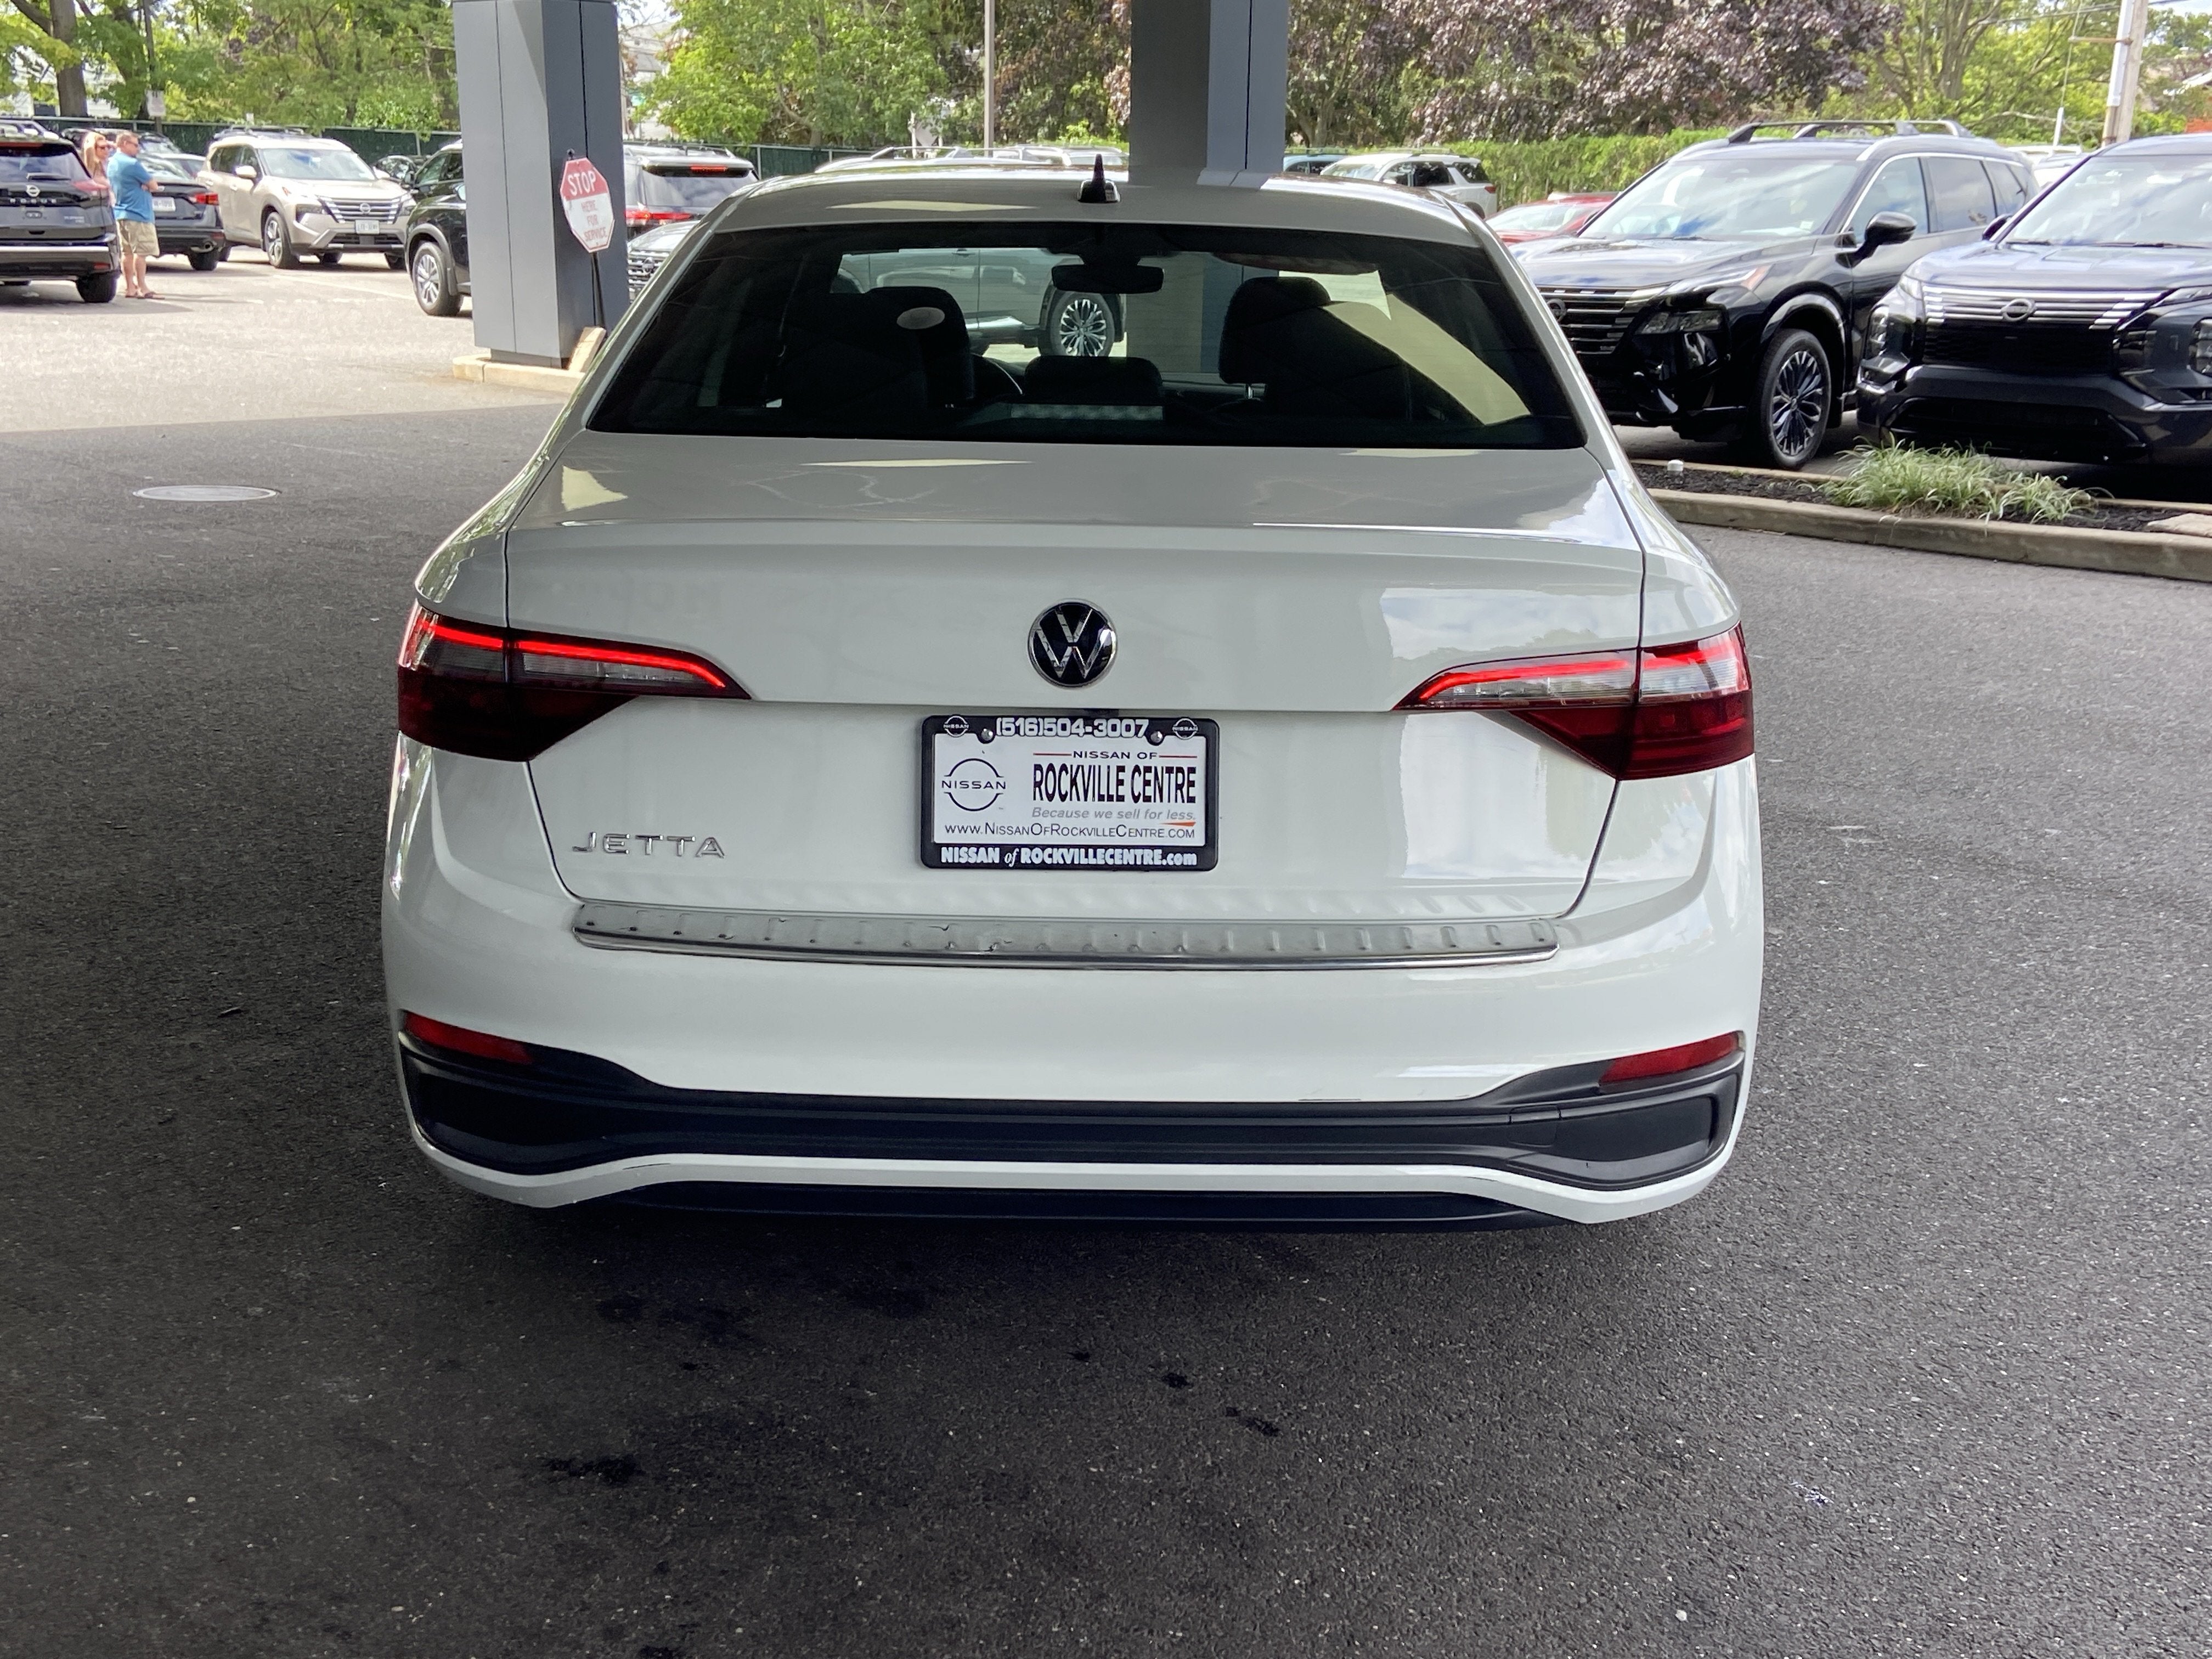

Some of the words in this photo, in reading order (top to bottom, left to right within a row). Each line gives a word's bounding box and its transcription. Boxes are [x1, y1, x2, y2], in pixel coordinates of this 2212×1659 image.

[568, 171, 596, 196] STOP
[581, 200, 597, 212] HERE
[587, 215, 599, 226] FOR
[583, 227, 608, 241] SERVICE
[996, 716, 1149, 738] (516)504-3007
[1073, 750, 1131, 759] NISSAN
[1137, 752, 1158, 760] OF
[941, 780, 1007, 790] NISSAN
[1032, 763, 1125, 803] ROCKVILLE
[1131, 766, 1197, 804] CENTRE
[1031, 807, 1090, 819] Because
[1094, 810, 1113, 819] we
[1117, 809, 1142, 820] sell
[1145, 809, 1164, 820] for
[1166, 810, 1197, 821] less.
[573, 831, 725, 859] JETTA
[941, 847, 1000, 864] NISSAN
[1003, 848, 1019, 868] of
[1020, 848, 1198, 866] ROCKVILLECENTRE.com
